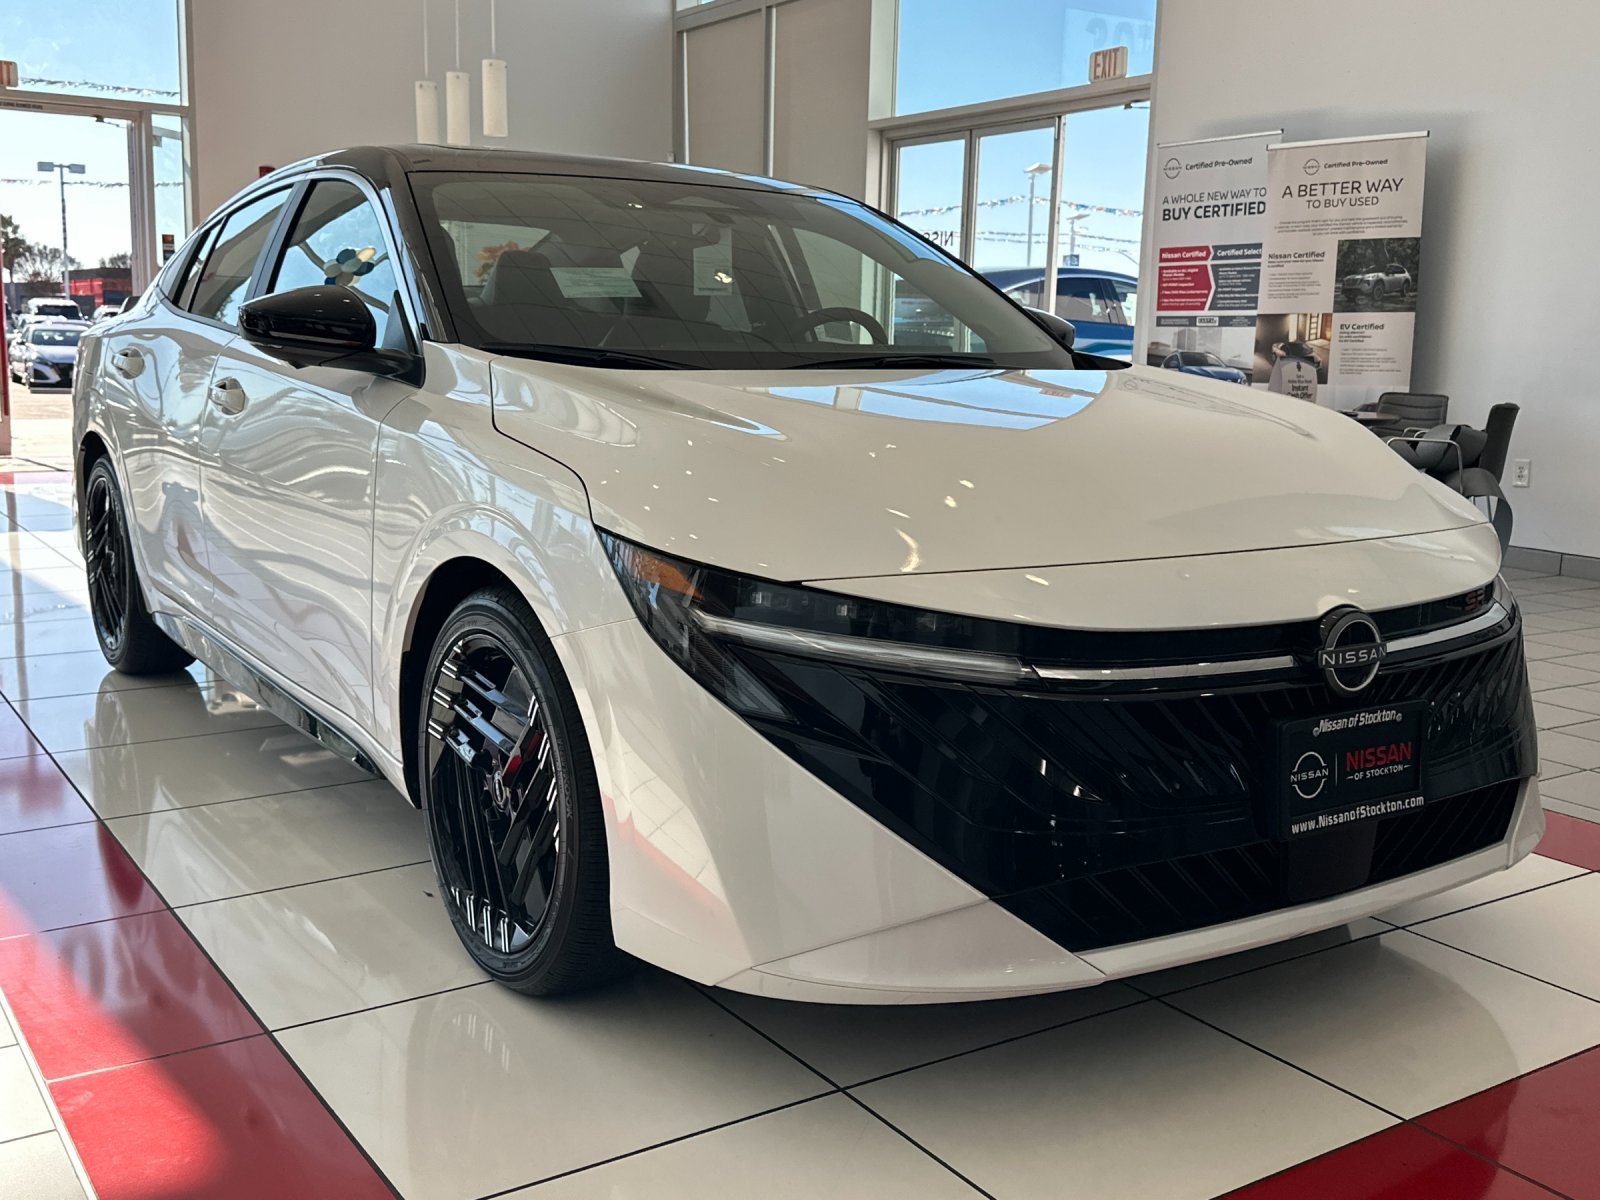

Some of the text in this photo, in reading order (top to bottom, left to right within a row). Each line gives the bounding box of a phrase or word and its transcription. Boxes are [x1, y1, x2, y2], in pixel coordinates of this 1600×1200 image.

[1093, 48, 1119, 80] EXIT
[1185, 158, 1252, 171] Certified Pre-Owned
[1323, 159, 1388, 169] Certified Pre-Owned
[1162, 187, 1267, 205] A WHOLE NEW WAY TO
[1281, 178, 1404, 198] A BETTER WAY
[1162, 201, 1266, 221] BUY CERTIFIED
[1306, 196, 1379, 209] TO BUY USED
[1216, 247, 1262, 257] Certified Select
[1268, 251, 1326, 260] Nissan Certified
[1351, 322, 1385, 331] Certified
[1322, 646, 1386, 665] NISSAN
[1319, 709, 1396, 733] Nissan of Stockton
[1346, 742, 1411, 772] NISSAN
[1290, 768, 1329, 783] NISSAN
[1354, 764, 1403, 780] OF STOCKTON
[1291, 795, 1425, 834] www.NissanofStockton.com
